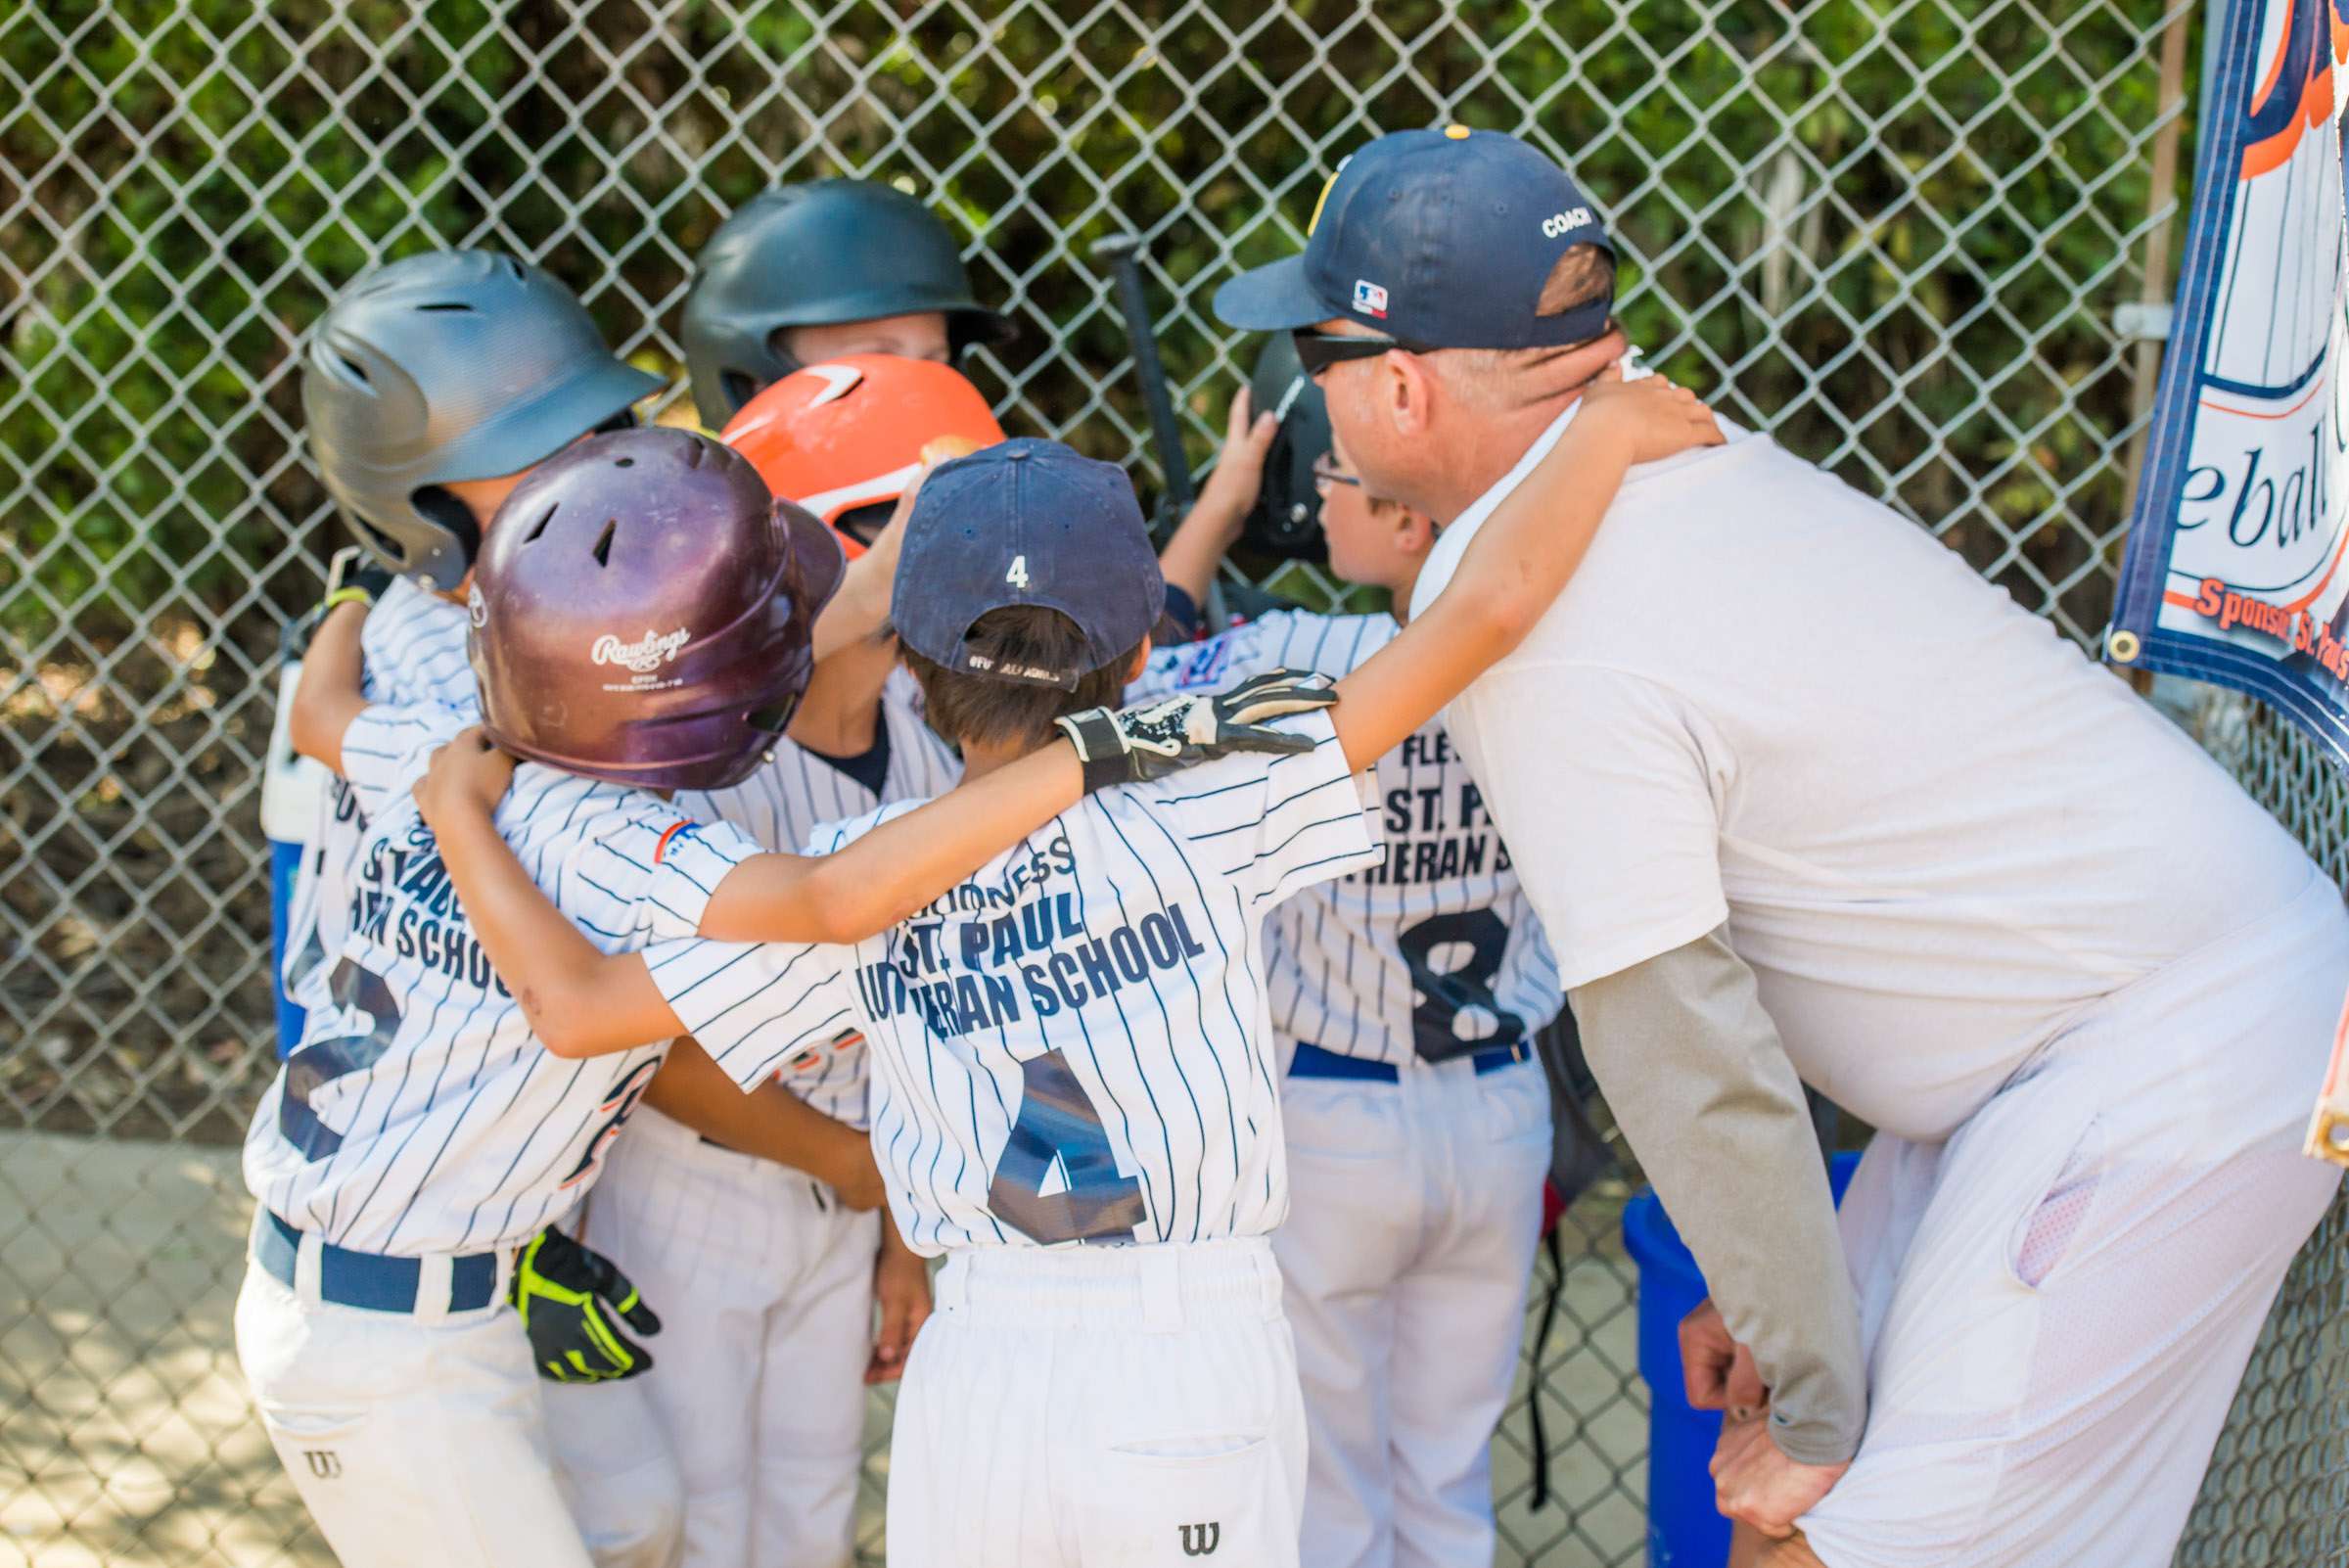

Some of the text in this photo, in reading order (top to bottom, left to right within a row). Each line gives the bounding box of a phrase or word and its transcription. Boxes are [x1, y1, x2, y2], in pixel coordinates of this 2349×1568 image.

[1006, 555, 1029, 588] 4
[591, 627, 691, 666] Rawlings
[1403, 726, 1460, 766] FLE
[1386, 787, 1446, 834] ST.
[1336, 835, 1486, 888] HERAN
[898, 893, 1083, 979] ST. PAUL
[1021, 903, 1204, 1017] SCHOOL
[1398, 907, 1526, 1064] 8
[987, 1046, 1147, 1246] 4
